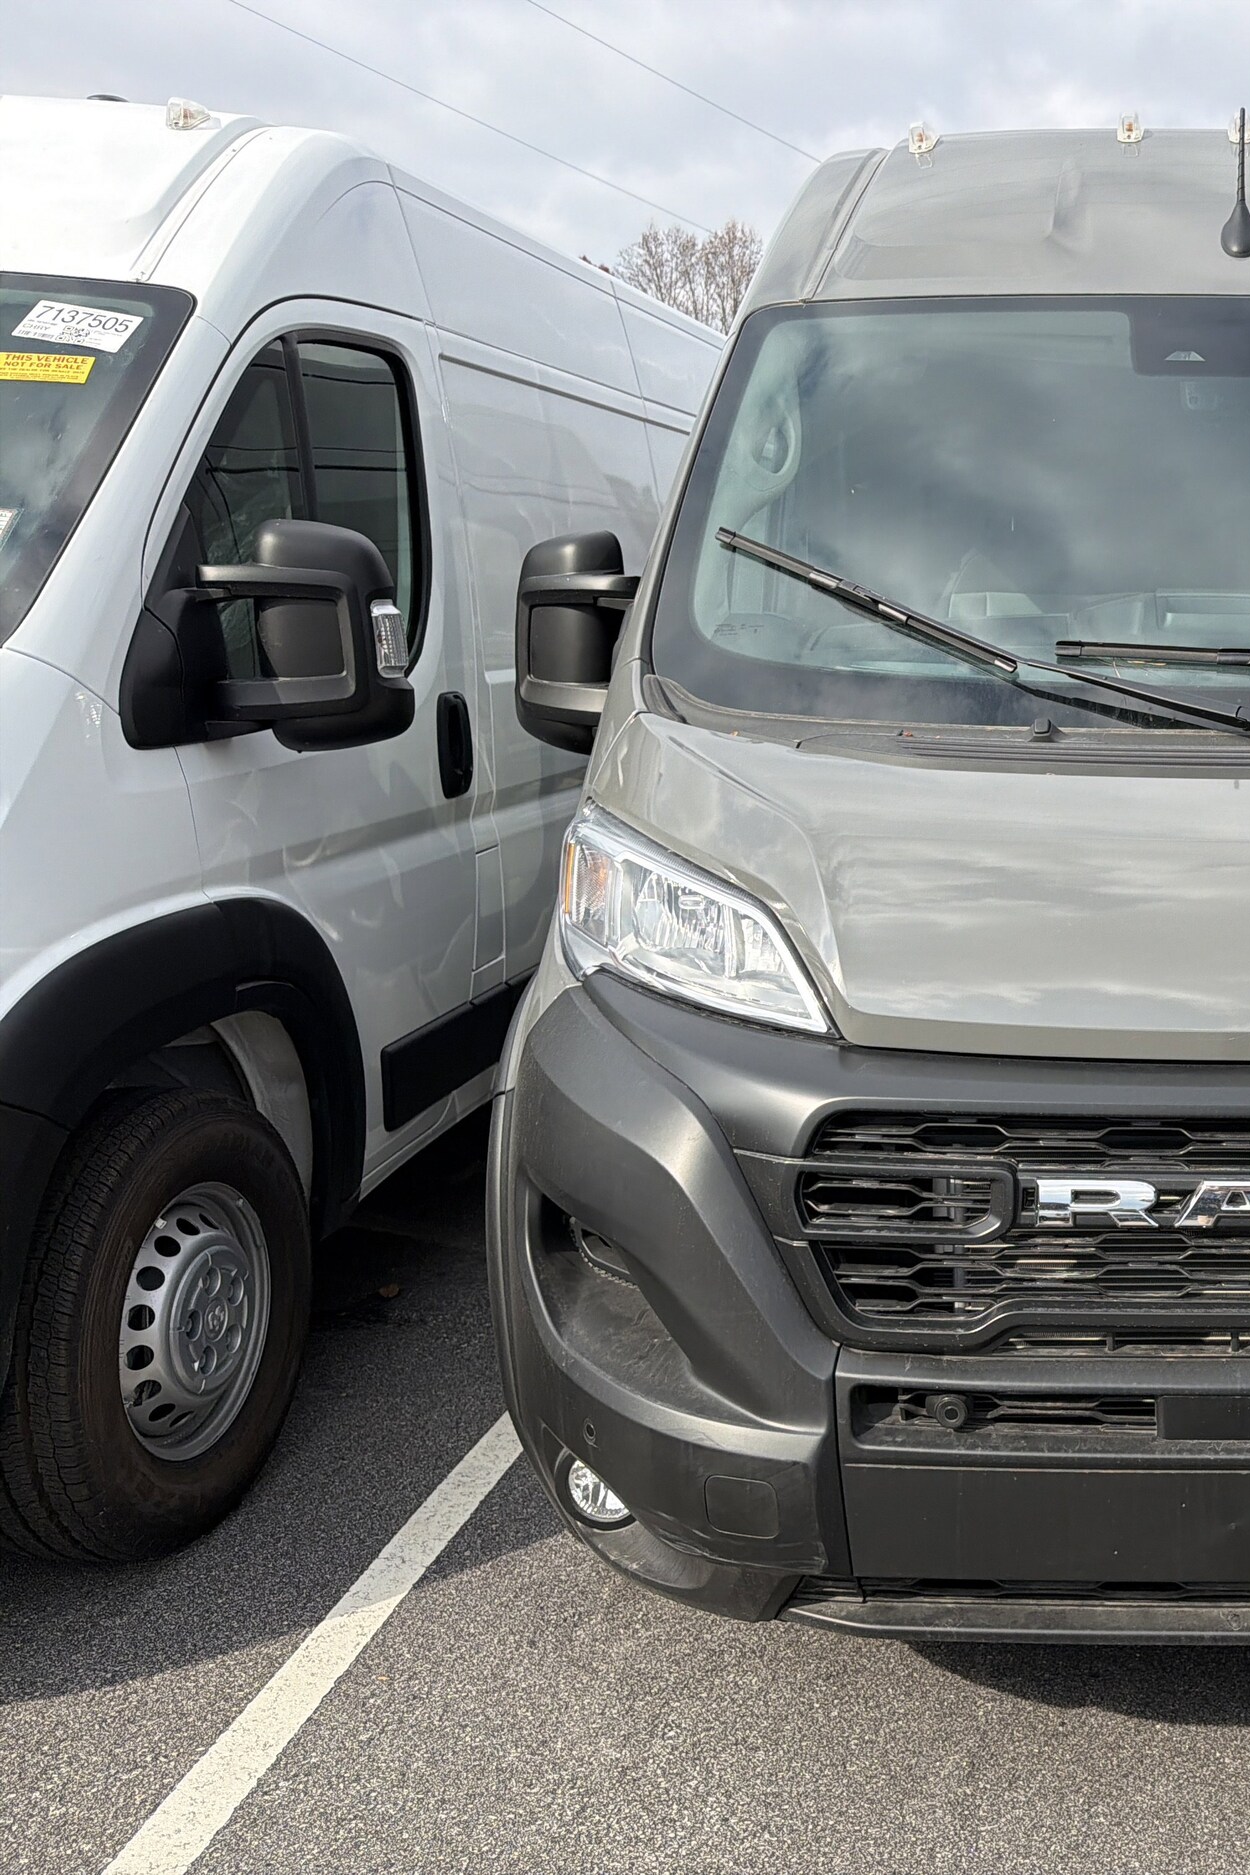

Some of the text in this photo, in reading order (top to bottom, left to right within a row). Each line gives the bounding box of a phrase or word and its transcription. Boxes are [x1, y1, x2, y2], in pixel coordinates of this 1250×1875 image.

[36, 305, 133, 333] 7137505
[5, 353, 89, 365] THIS VEHICLE
[55, 363, 84, 371] SALE
